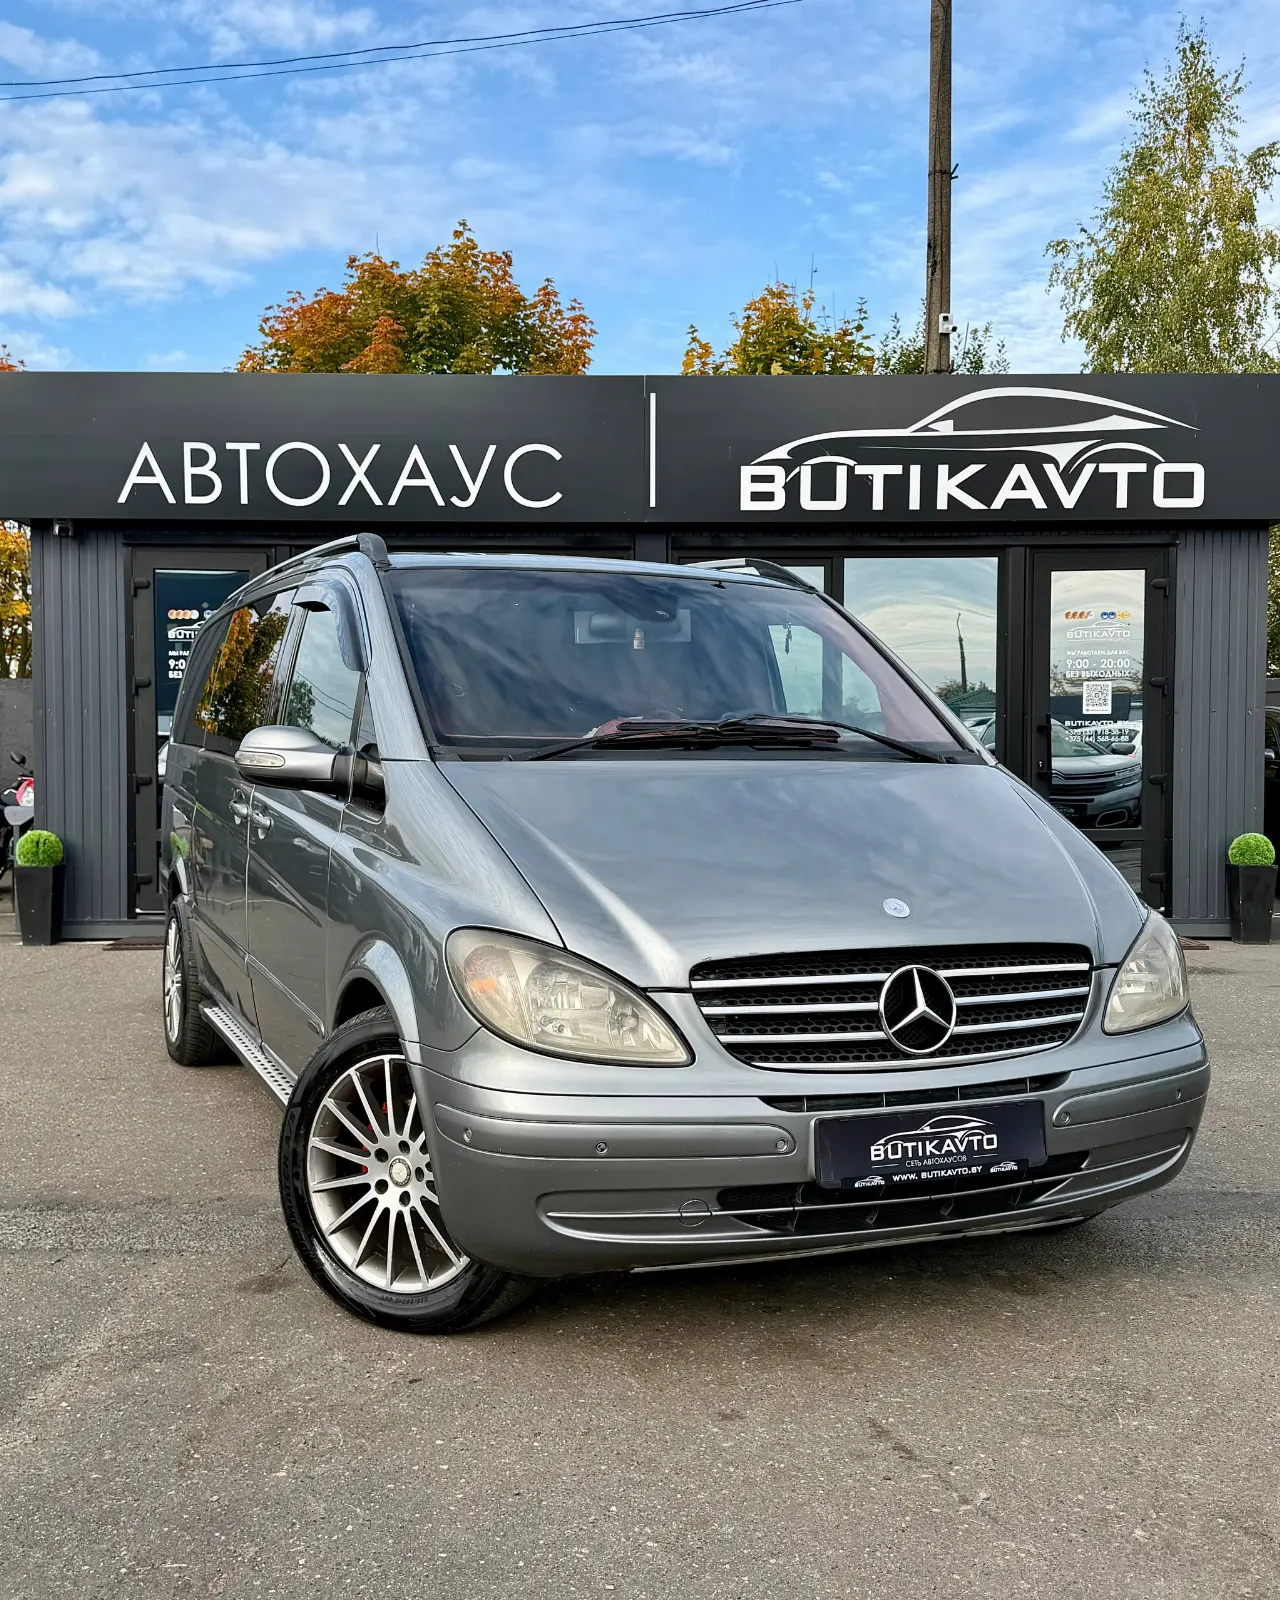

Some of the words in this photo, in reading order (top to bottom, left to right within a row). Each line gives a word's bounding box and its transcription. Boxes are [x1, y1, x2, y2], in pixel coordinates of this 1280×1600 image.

[117, 441, 564, 509] АВТОХАУС
[739, 462, 1206, 511] BUTIKAVTO
[1066, 630, 1131, 638] BUTIKAVTO
[1066, 659, 1089, 669] 9:00
[1100, 658, 1131, 668] 20:00
[1081, 670, 1130, 678] ВЫХОДНЫХ
[870, 1133, 998, 1162] BUTIKAVTO
[905, 1159, 922, 1168] СЕТЬ
[923, 1155, 967, 1166] АВТОХАУСОВ
[892, 1172, 918, 1182] WWW.
[921, 1166, 983, 1179] BUTIKAVTO.BY
